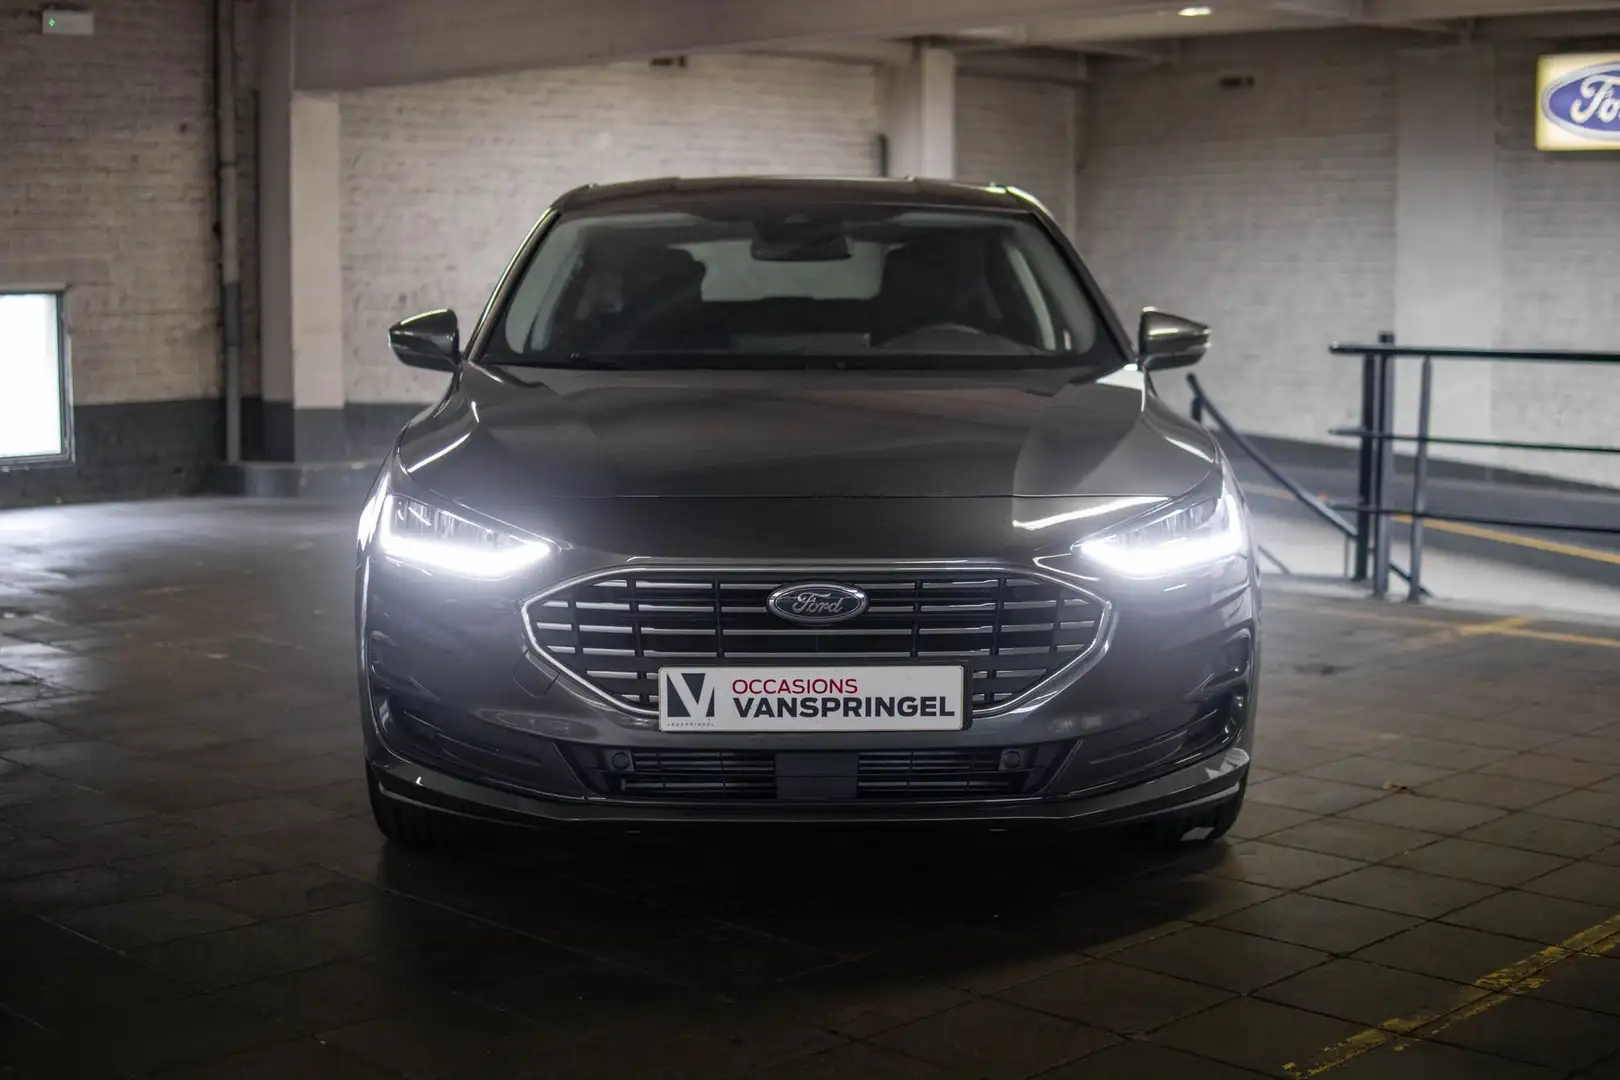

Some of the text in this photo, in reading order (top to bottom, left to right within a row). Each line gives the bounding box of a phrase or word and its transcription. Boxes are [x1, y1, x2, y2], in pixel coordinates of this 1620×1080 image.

[1569, 74, 1620, 124] Fo
[792, 592, 843, 613] Ford
[732, 678, 858, 694] OCCASIONS
[732, 696, 955, 718] VANSPRINGEL
